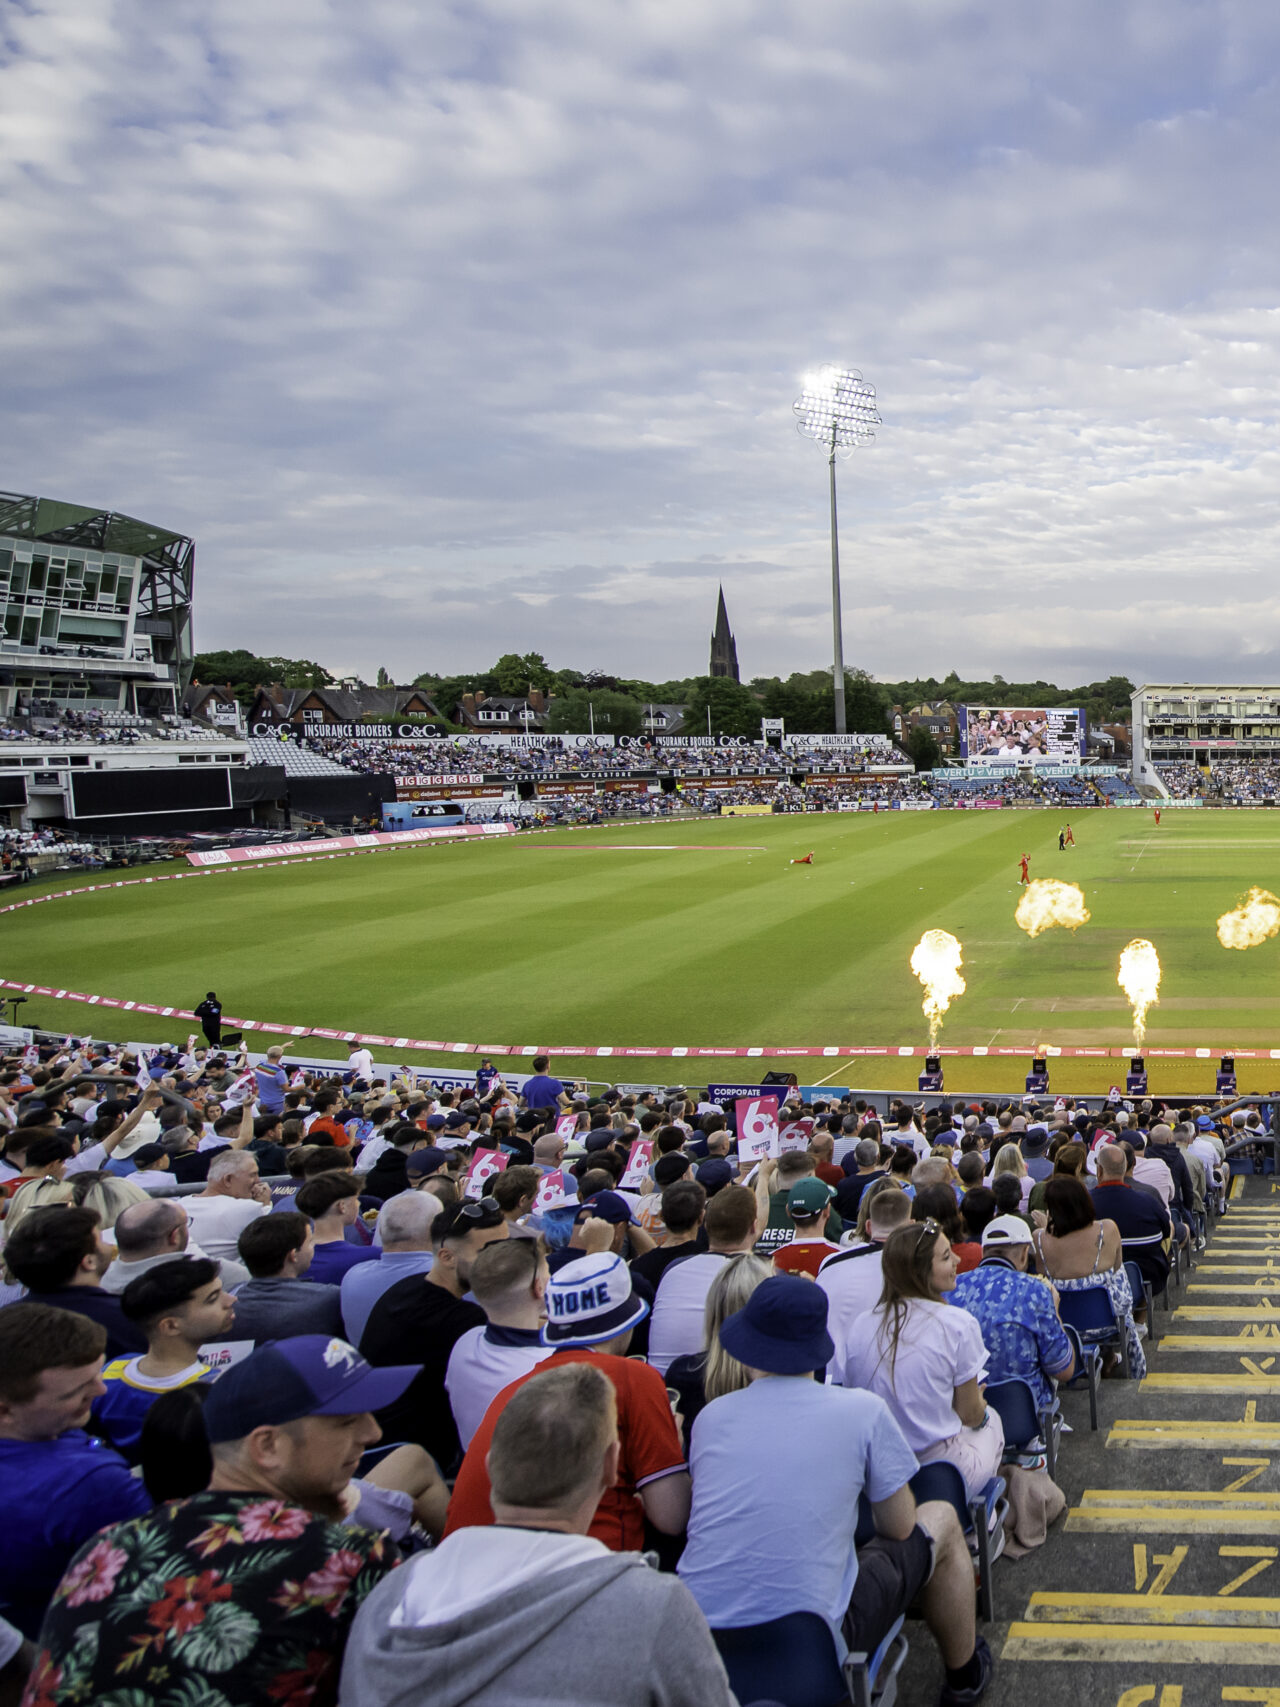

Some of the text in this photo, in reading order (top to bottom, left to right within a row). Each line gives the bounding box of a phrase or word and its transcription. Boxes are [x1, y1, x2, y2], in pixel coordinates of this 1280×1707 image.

[304, 724, 392, 738] INSURANCE BROKERS
[398, 724, 442, 738] C&C.
[656, 736, 716, 746] INSURANCE BROKERS
[720, 736, 750, 746] C&C.
[822, 736, 854, 744] HEALTHCARE
[856, 736, 884, 745] C&C.
[986, 768, 1017, 776] VERTU
[1086, 766, 1117, 774] VERTU
[446, 776, 454, 784] IG
[460, 776, 468, 784] IG
[245, 846, 275, 858] Health
[284, 844, 300, 855] Life
[714, 1088, 761, 1096] CORPORATE
[743, 1100, 769, 1140] 6
[473, 1153, 494, 1178] 6
[552, 1282, 612, 1316] HOME
